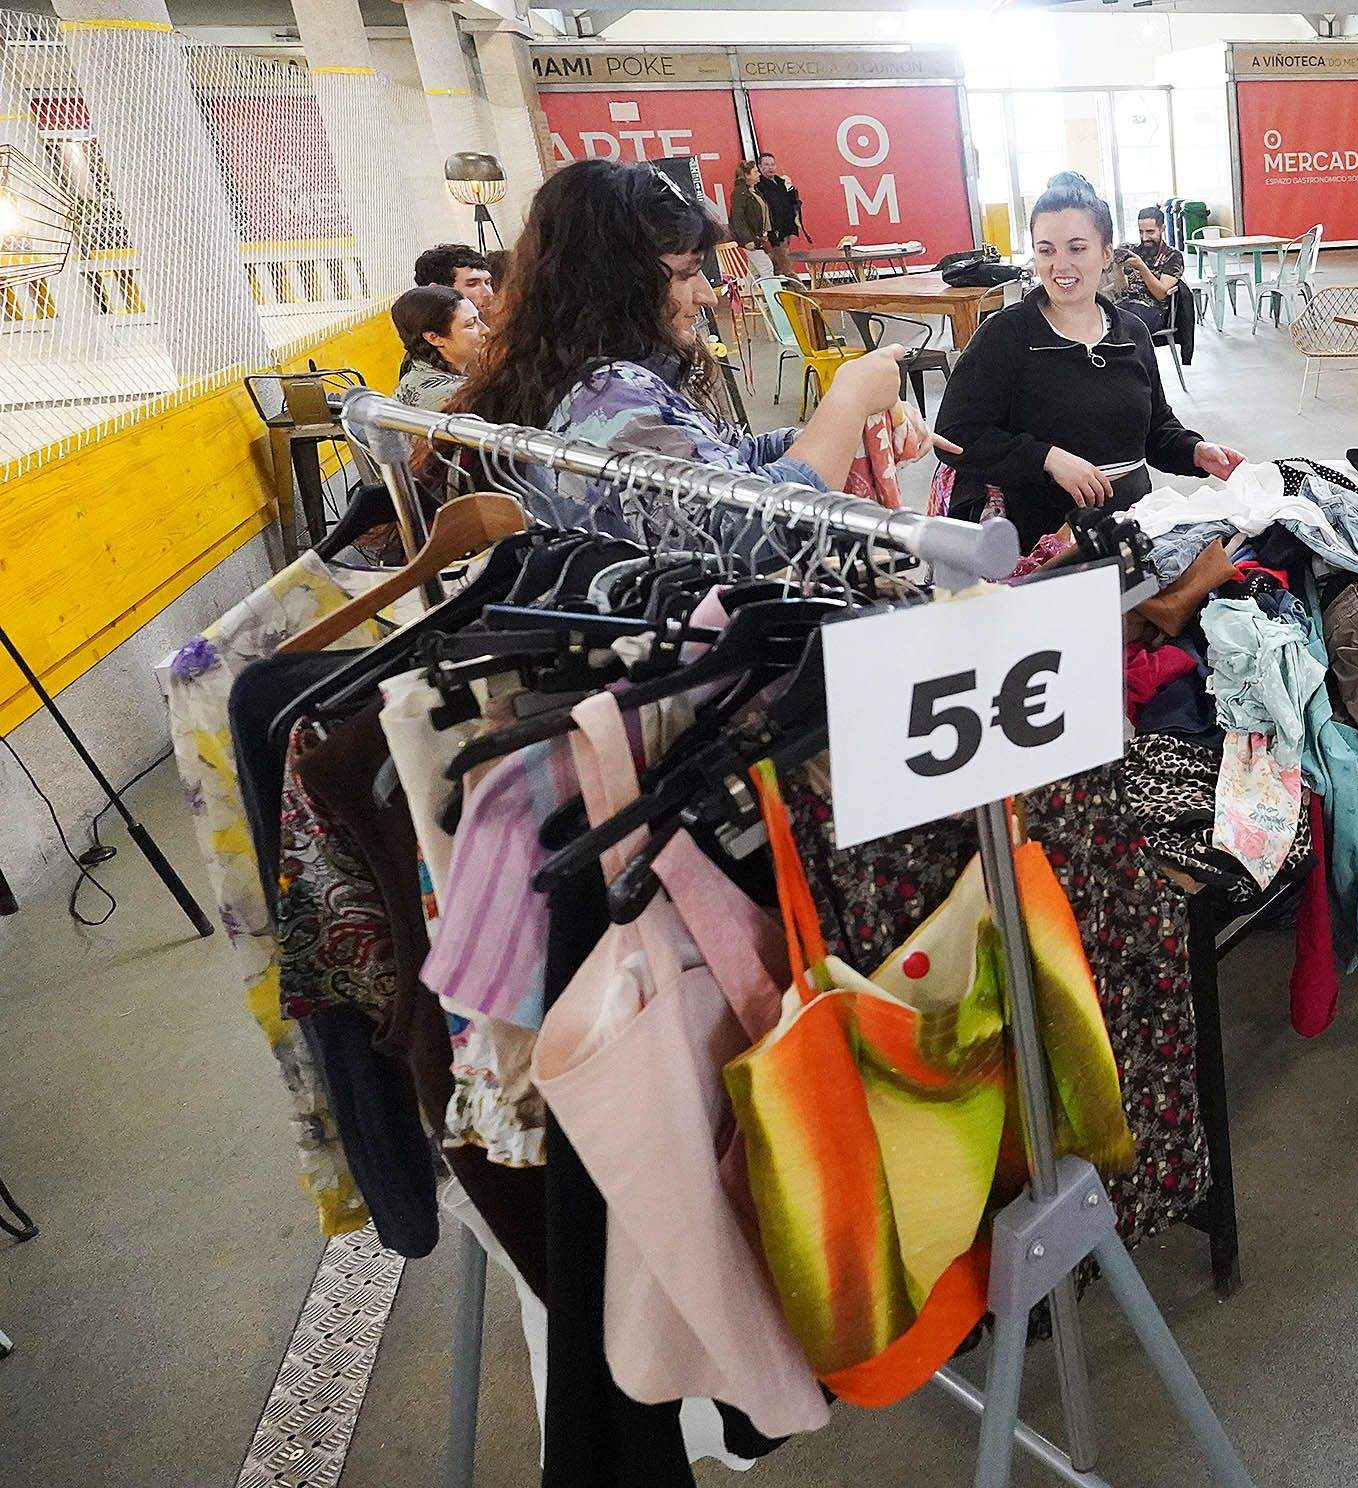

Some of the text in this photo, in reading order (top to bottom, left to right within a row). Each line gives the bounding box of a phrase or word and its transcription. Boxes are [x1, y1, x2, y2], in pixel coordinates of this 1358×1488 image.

[606, 56, 675, 76] POKE
[1252, 57, 1260, 67] A
[1262, 53, 1326, 67] VIÑOTECA
[1263, 129, 1282, 150] O
[839, 173, 901, 226] M
[905, 650, 1065, 777] 5€
